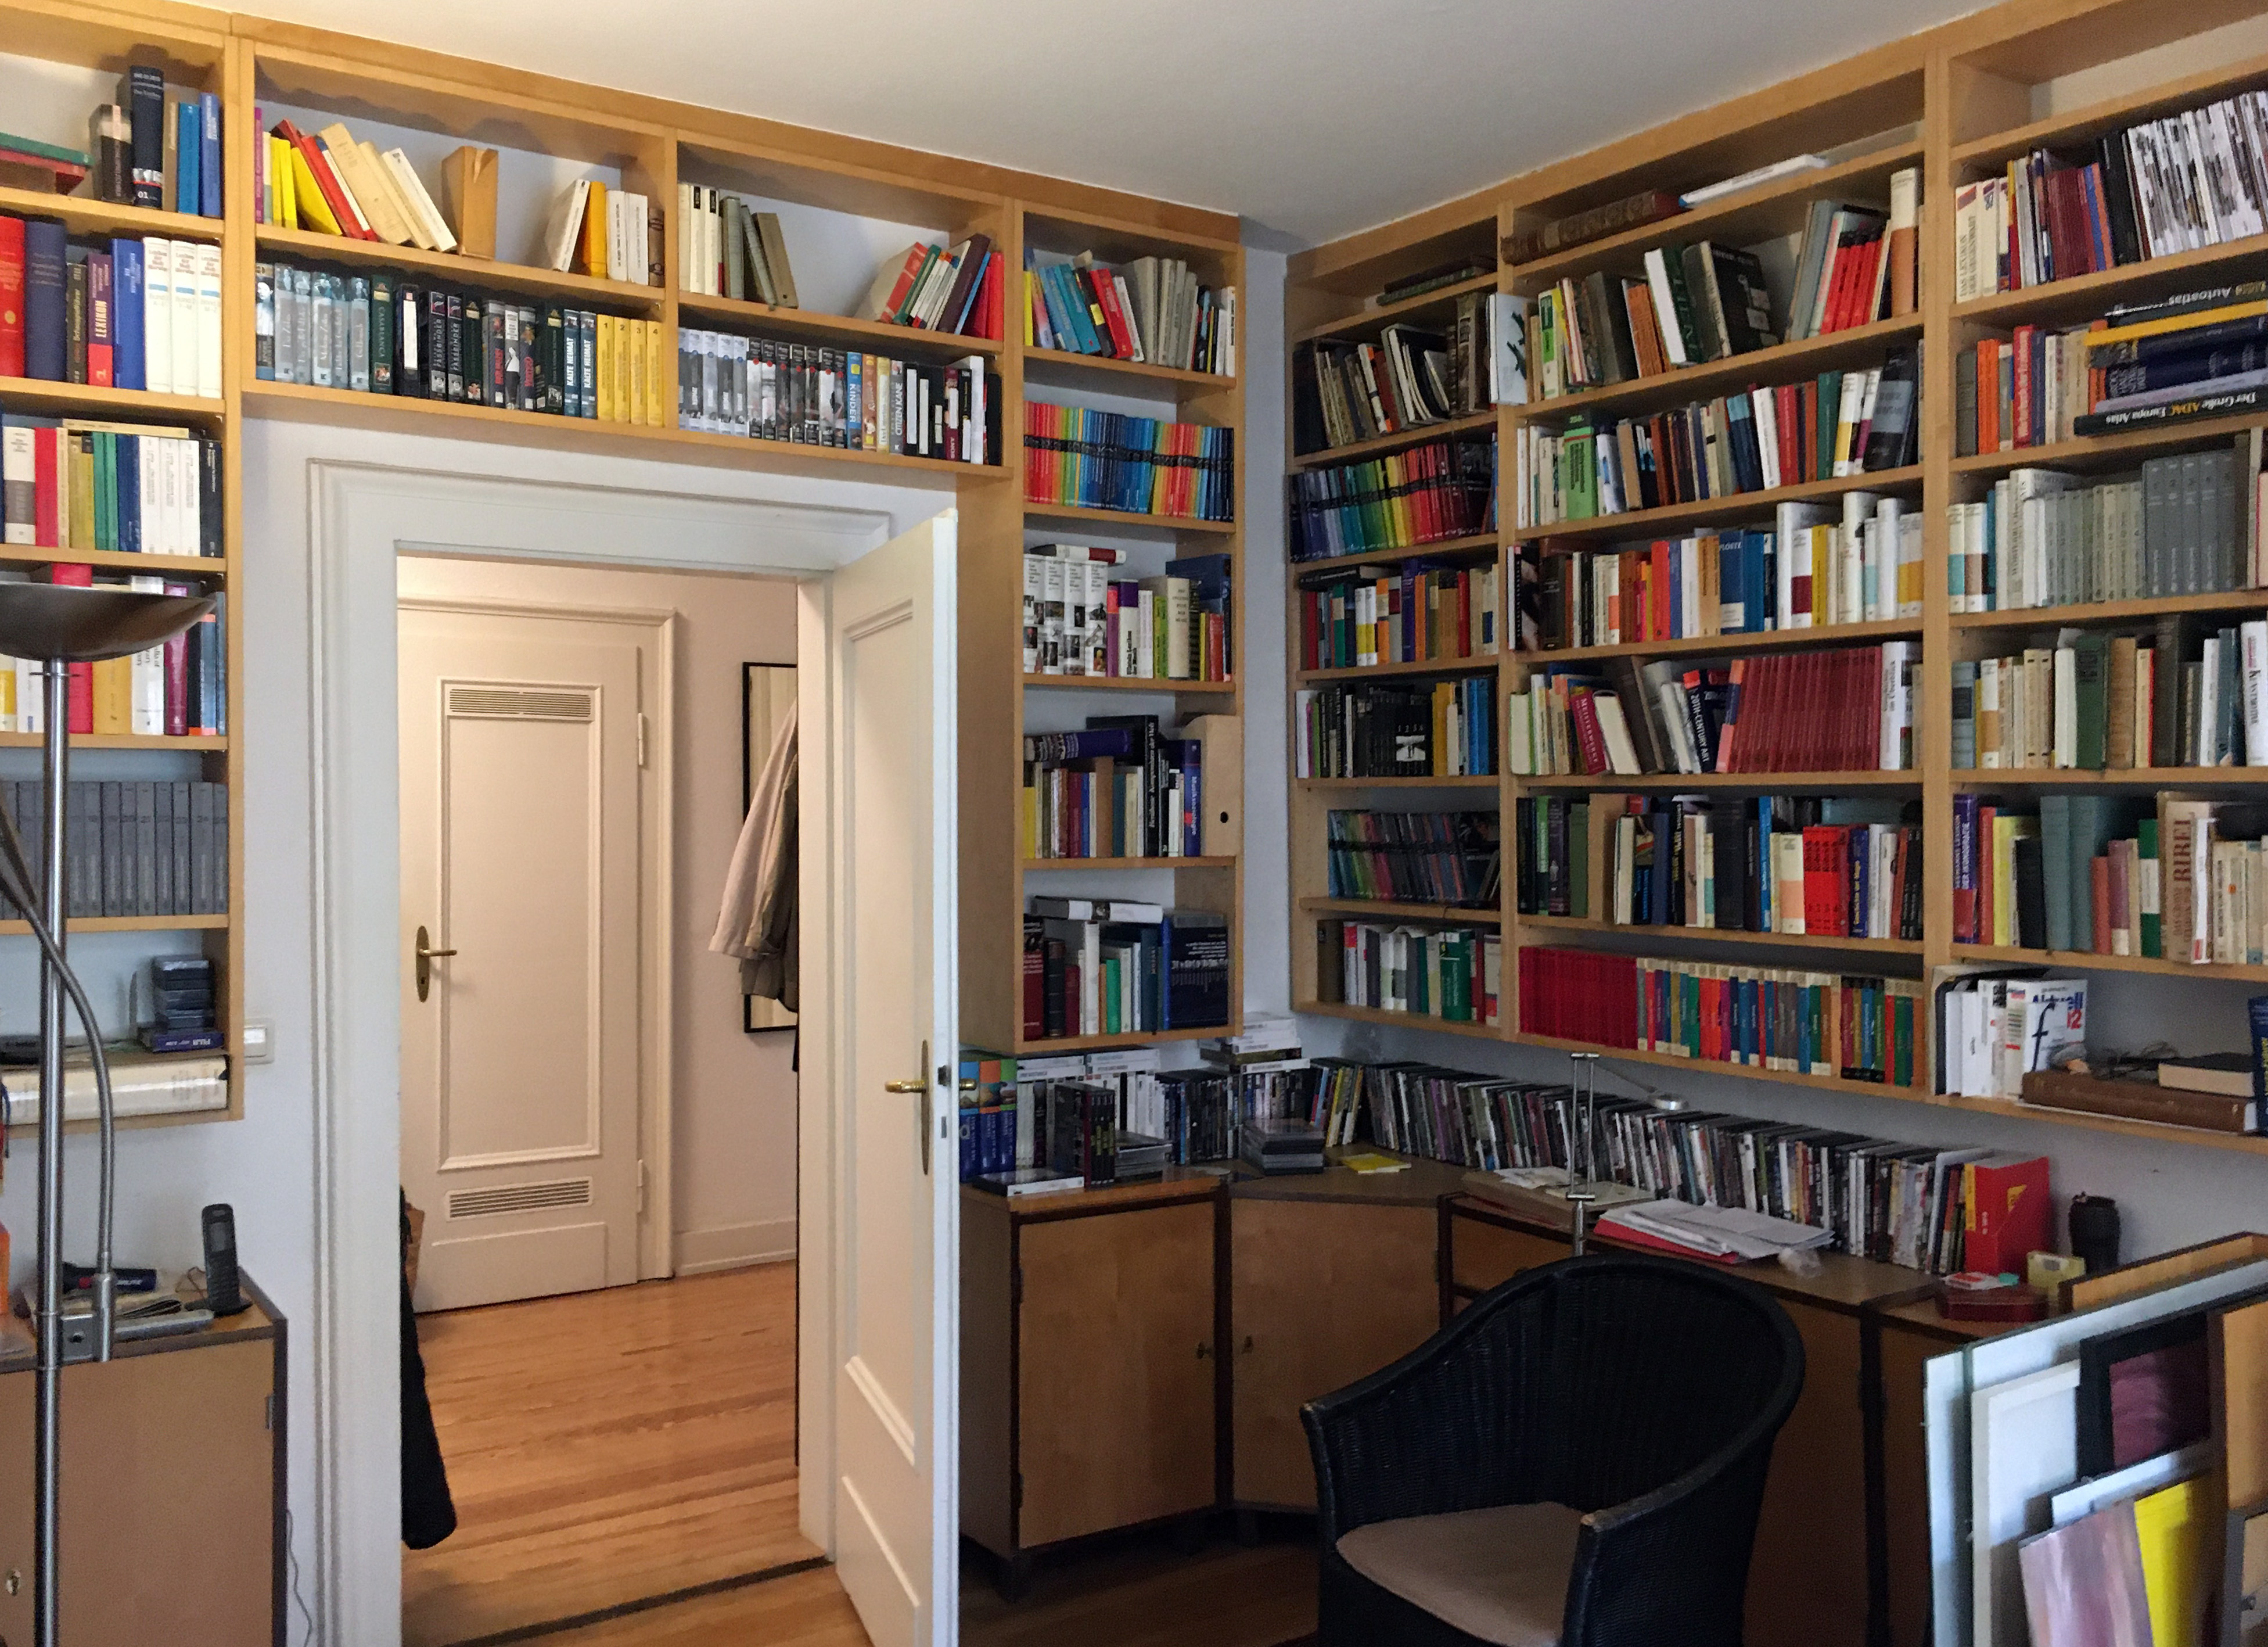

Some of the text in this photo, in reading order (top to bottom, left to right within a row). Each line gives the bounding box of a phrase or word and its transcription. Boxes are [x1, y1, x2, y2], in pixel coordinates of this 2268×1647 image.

[137, 191, 148, 199] 01
[2168, 286, 2232, 306] Autoatlas
[95, 300, 107, 338] LEXIKON
[378, 306, 386, 358] CASABLANCA
[583, 339, 591, 389] KALTE HEIMAT
[2105, 391, 2257, 425] Der Große ADAC Europa Atlas
[1581, 698, 1598, 763] MEISTERWERKE
[1690, 694, 1710, 762] 20TH-CENTURY ART
[2067, 1009, 2083, 1029] 12
[191, 1038, 211, 1047] FUJI
